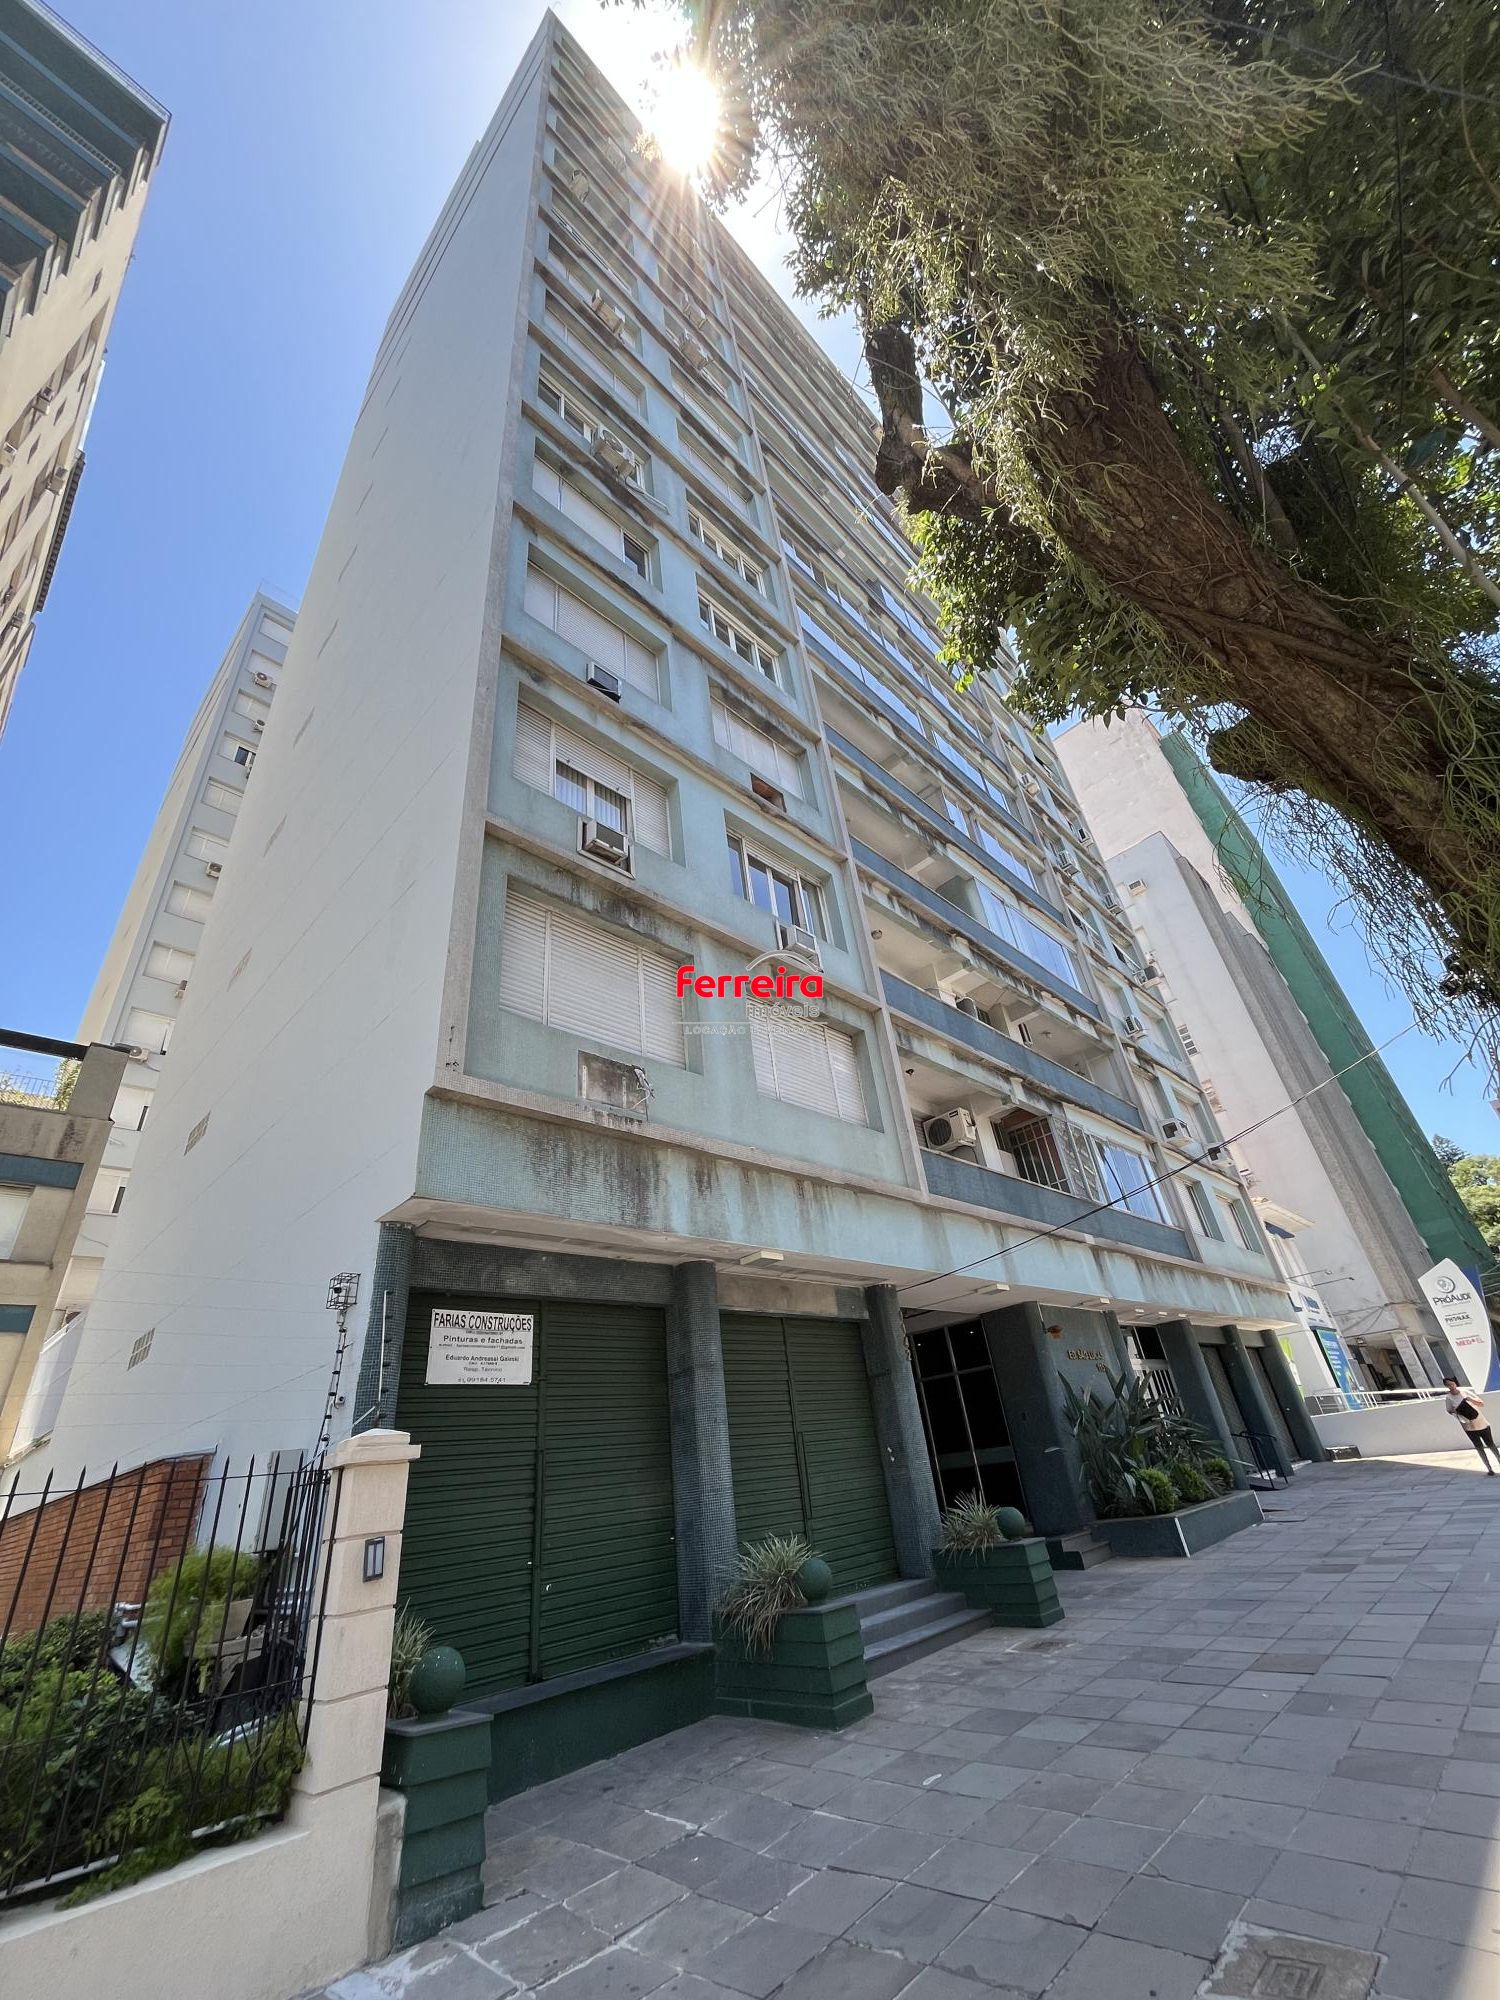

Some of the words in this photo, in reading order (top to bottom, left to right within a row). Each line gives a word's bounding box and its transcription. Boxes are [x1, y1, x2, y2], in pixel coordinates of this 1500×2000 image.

[434, 1312, 466, 1328] FARIAS
[468, 1315, 532, 1333] CONSTRUÇÕES
[443, 1335, 479, 1343] Pinturas
[487, 1336, 523, 1345] fachadas
